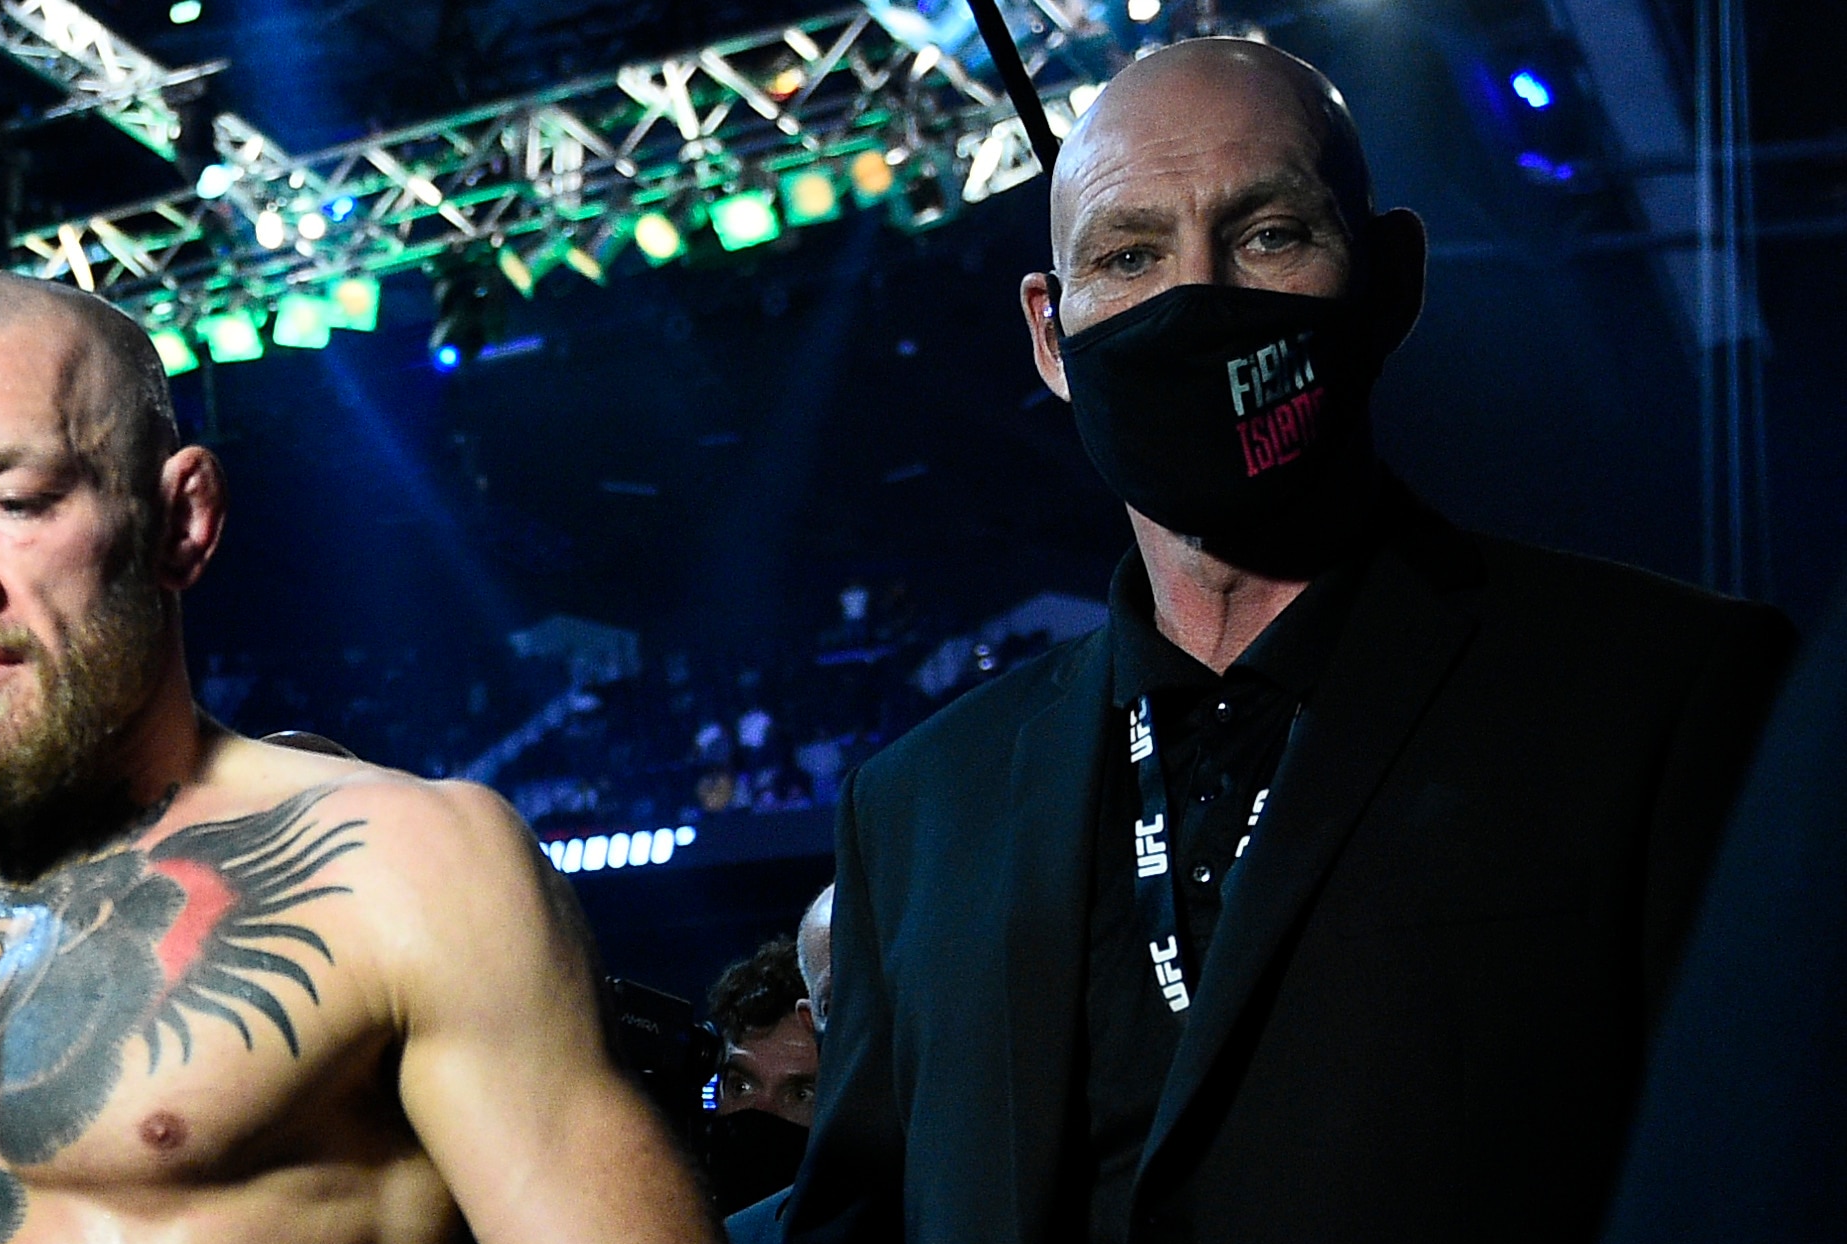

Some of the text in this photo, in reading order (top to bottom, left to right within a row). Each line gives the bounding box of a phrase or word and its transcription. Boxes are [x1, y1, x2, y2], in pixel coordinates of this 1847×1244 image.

[1129, 694, 1153, 764] UFC
[1134, 813, 1168, 878] UFC
[1148, 934, 1191, 1013] UFC
